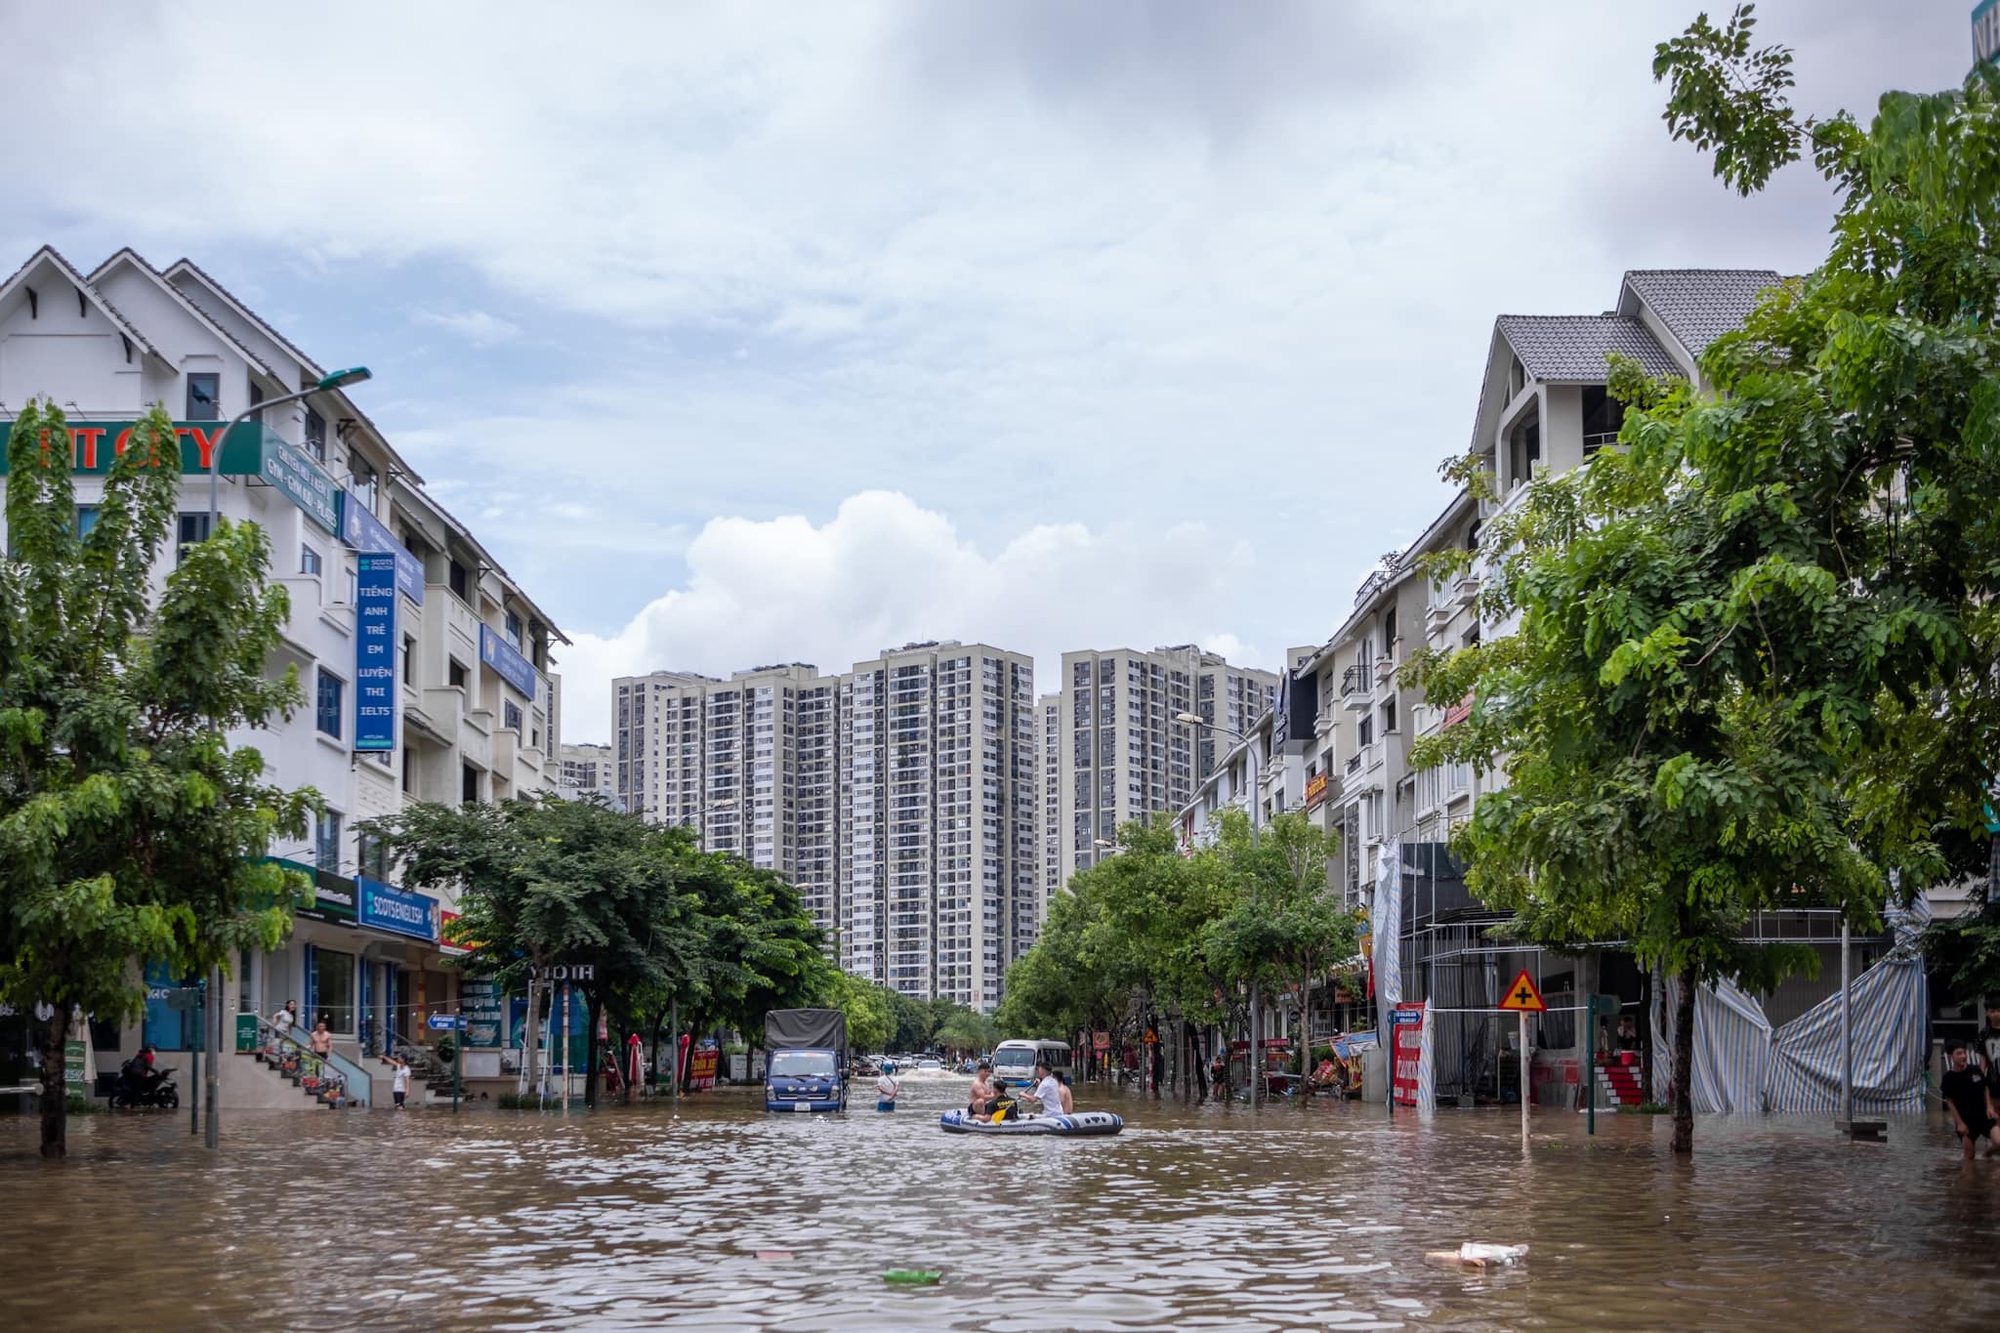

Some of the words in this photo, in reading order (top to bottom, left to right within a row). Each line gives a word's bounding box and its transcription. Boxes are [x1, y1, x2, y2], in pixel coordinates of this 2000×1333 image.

[267, 458, 283, 482] GYM
[359, 584, 392, 597] TIẾNG
[364, 607, 388, 616] ANH
[367, 644, 384, 654] EM
[359, 665, 392, 680] LUYỆN
[365, 687, 385, 697] THI
[360, 706, 390, 716] IELTS
